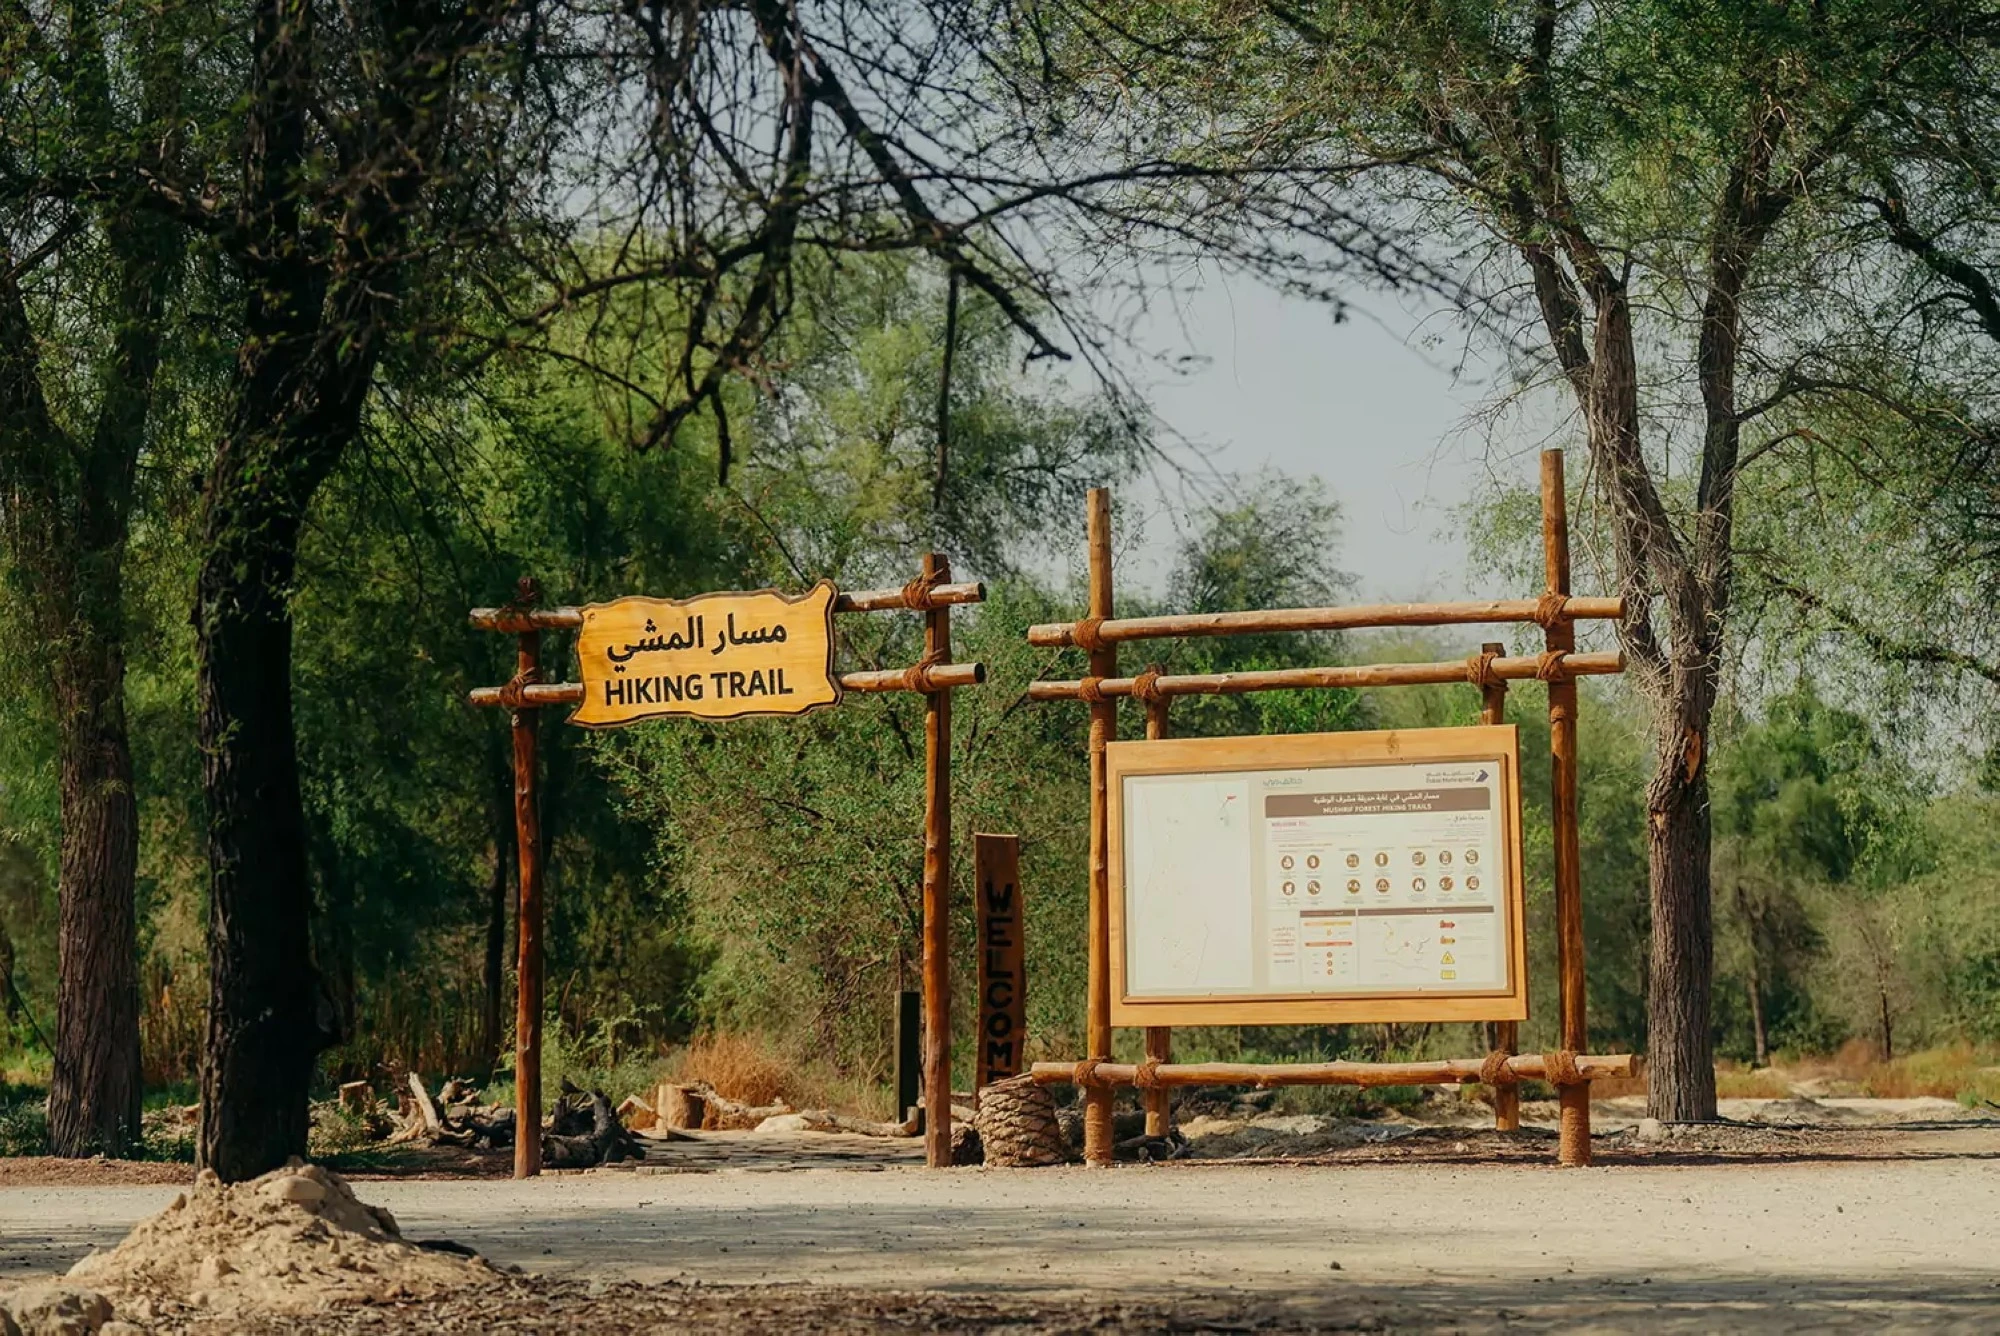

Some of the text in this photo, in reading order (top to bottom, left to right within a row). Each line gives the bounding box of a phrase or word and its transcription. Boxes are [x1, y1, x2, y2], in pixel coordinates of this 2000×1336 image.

[606, 612, 788, 673] مسار المشي
[605, 668, 794, 706] HIKING TRAIL
[1322, 803, 1432, 814] MUSHRIF FOREST HIKING TRAILS
